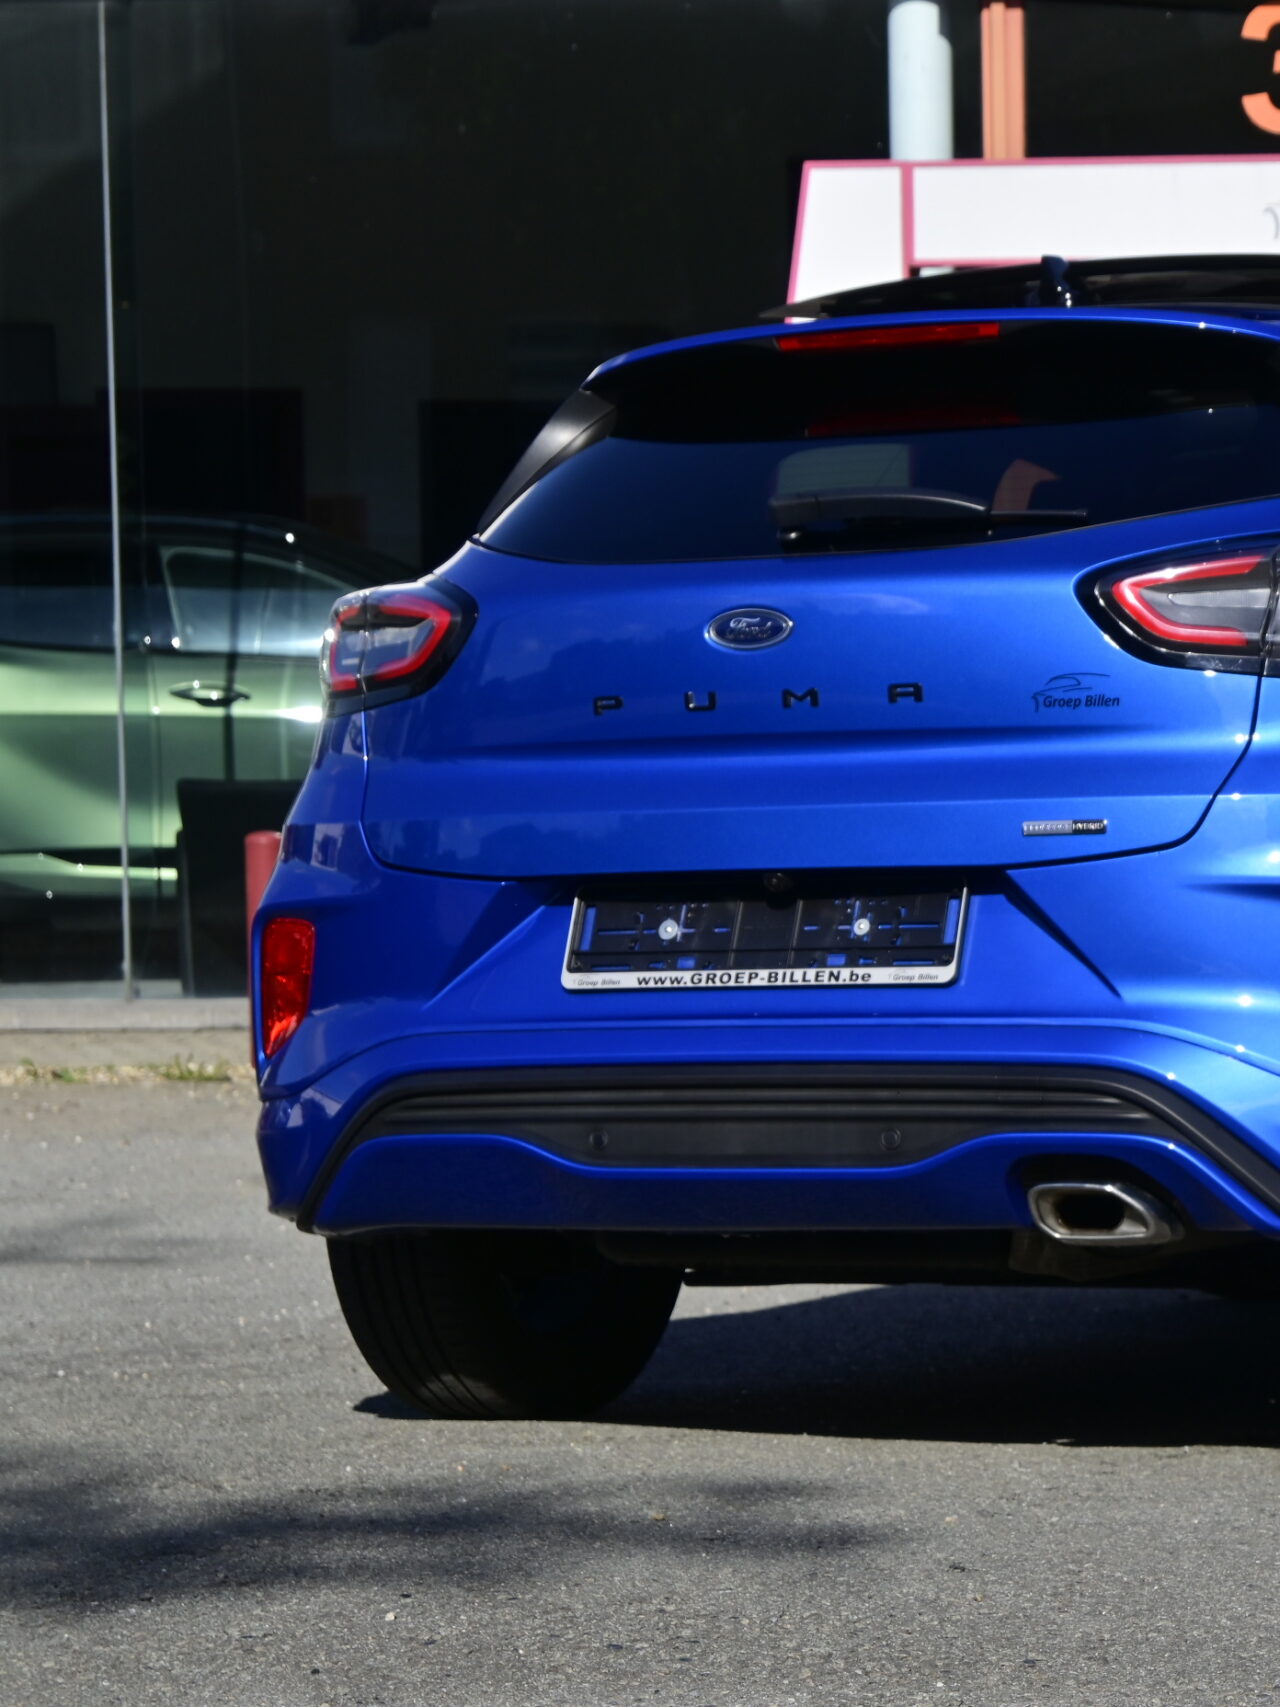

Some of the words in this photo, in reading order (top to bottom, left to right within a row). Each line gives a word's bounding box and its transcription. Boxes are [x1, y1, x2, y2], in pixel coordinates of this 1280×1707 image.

[593, 681, 924, 716] PUMA
[1043, 695, 1081, 710] Groep
[1084, 694, 1120, 707] Billen
[637, 970, 872, 986] www.GROEP-BILLEN.be
